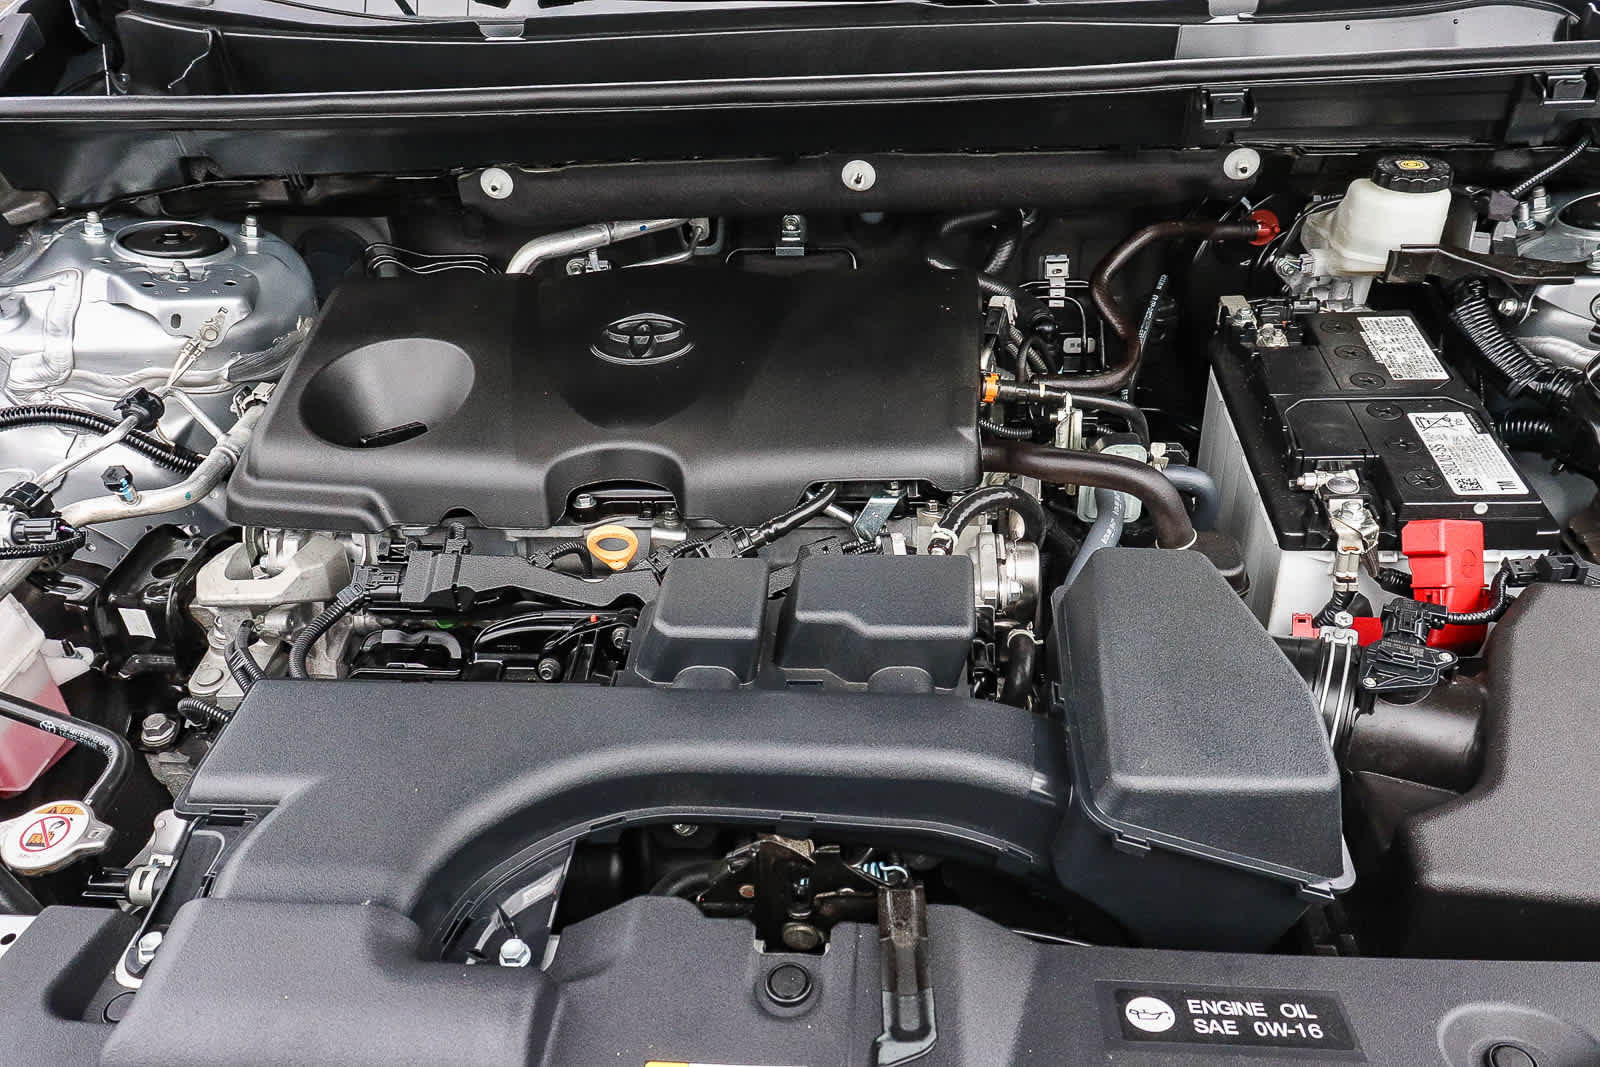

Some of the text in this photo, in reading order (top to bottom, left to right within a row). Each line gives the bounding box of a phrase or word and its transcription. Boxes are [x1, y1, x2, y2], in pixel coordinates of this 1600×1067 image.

[1187, 999, 1318, 1019] ENGINE OIL
[1193, 1018, 1324, 1039] SAE 0W-16
